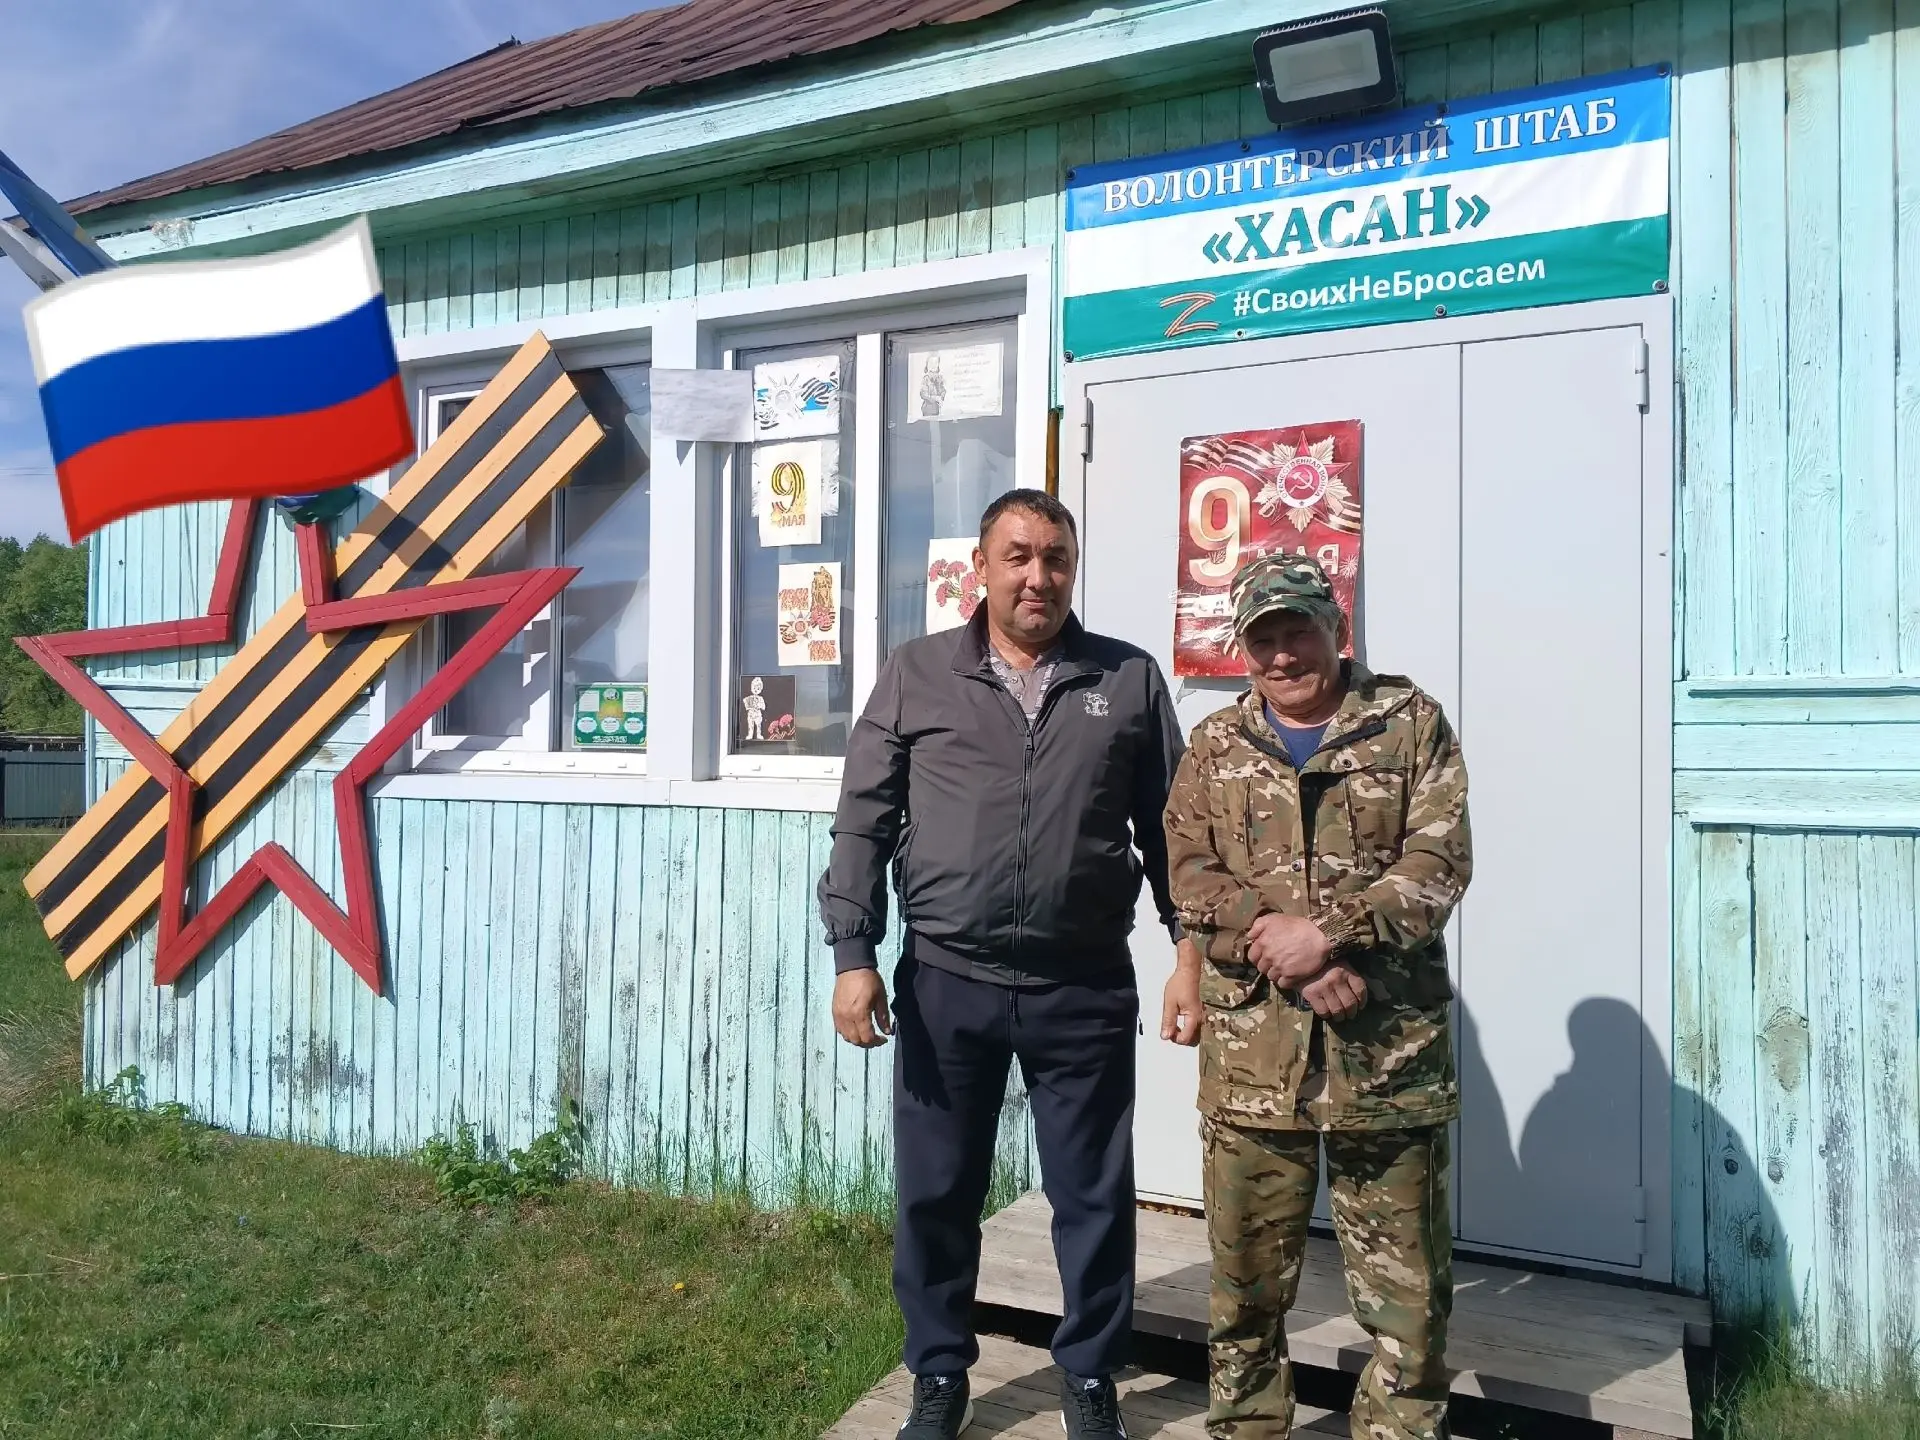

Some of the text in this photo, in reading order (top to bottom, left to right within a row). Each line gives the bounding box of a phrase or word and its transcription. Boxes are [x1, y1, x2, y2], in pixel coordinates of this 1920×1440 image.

[1103, 97, 1618, 213] ВОЛОНТЕРСКИЙ ШТАБ
[1202, 185, 1490, 264] «ХАСАН»
[1233, 257, 1547, 317] #СвоихНеБросаем
[771, 462, 805, 514] 9
[781, 514, 805, 527] МАЯ
[1188, 476, 1251, 587] 9
